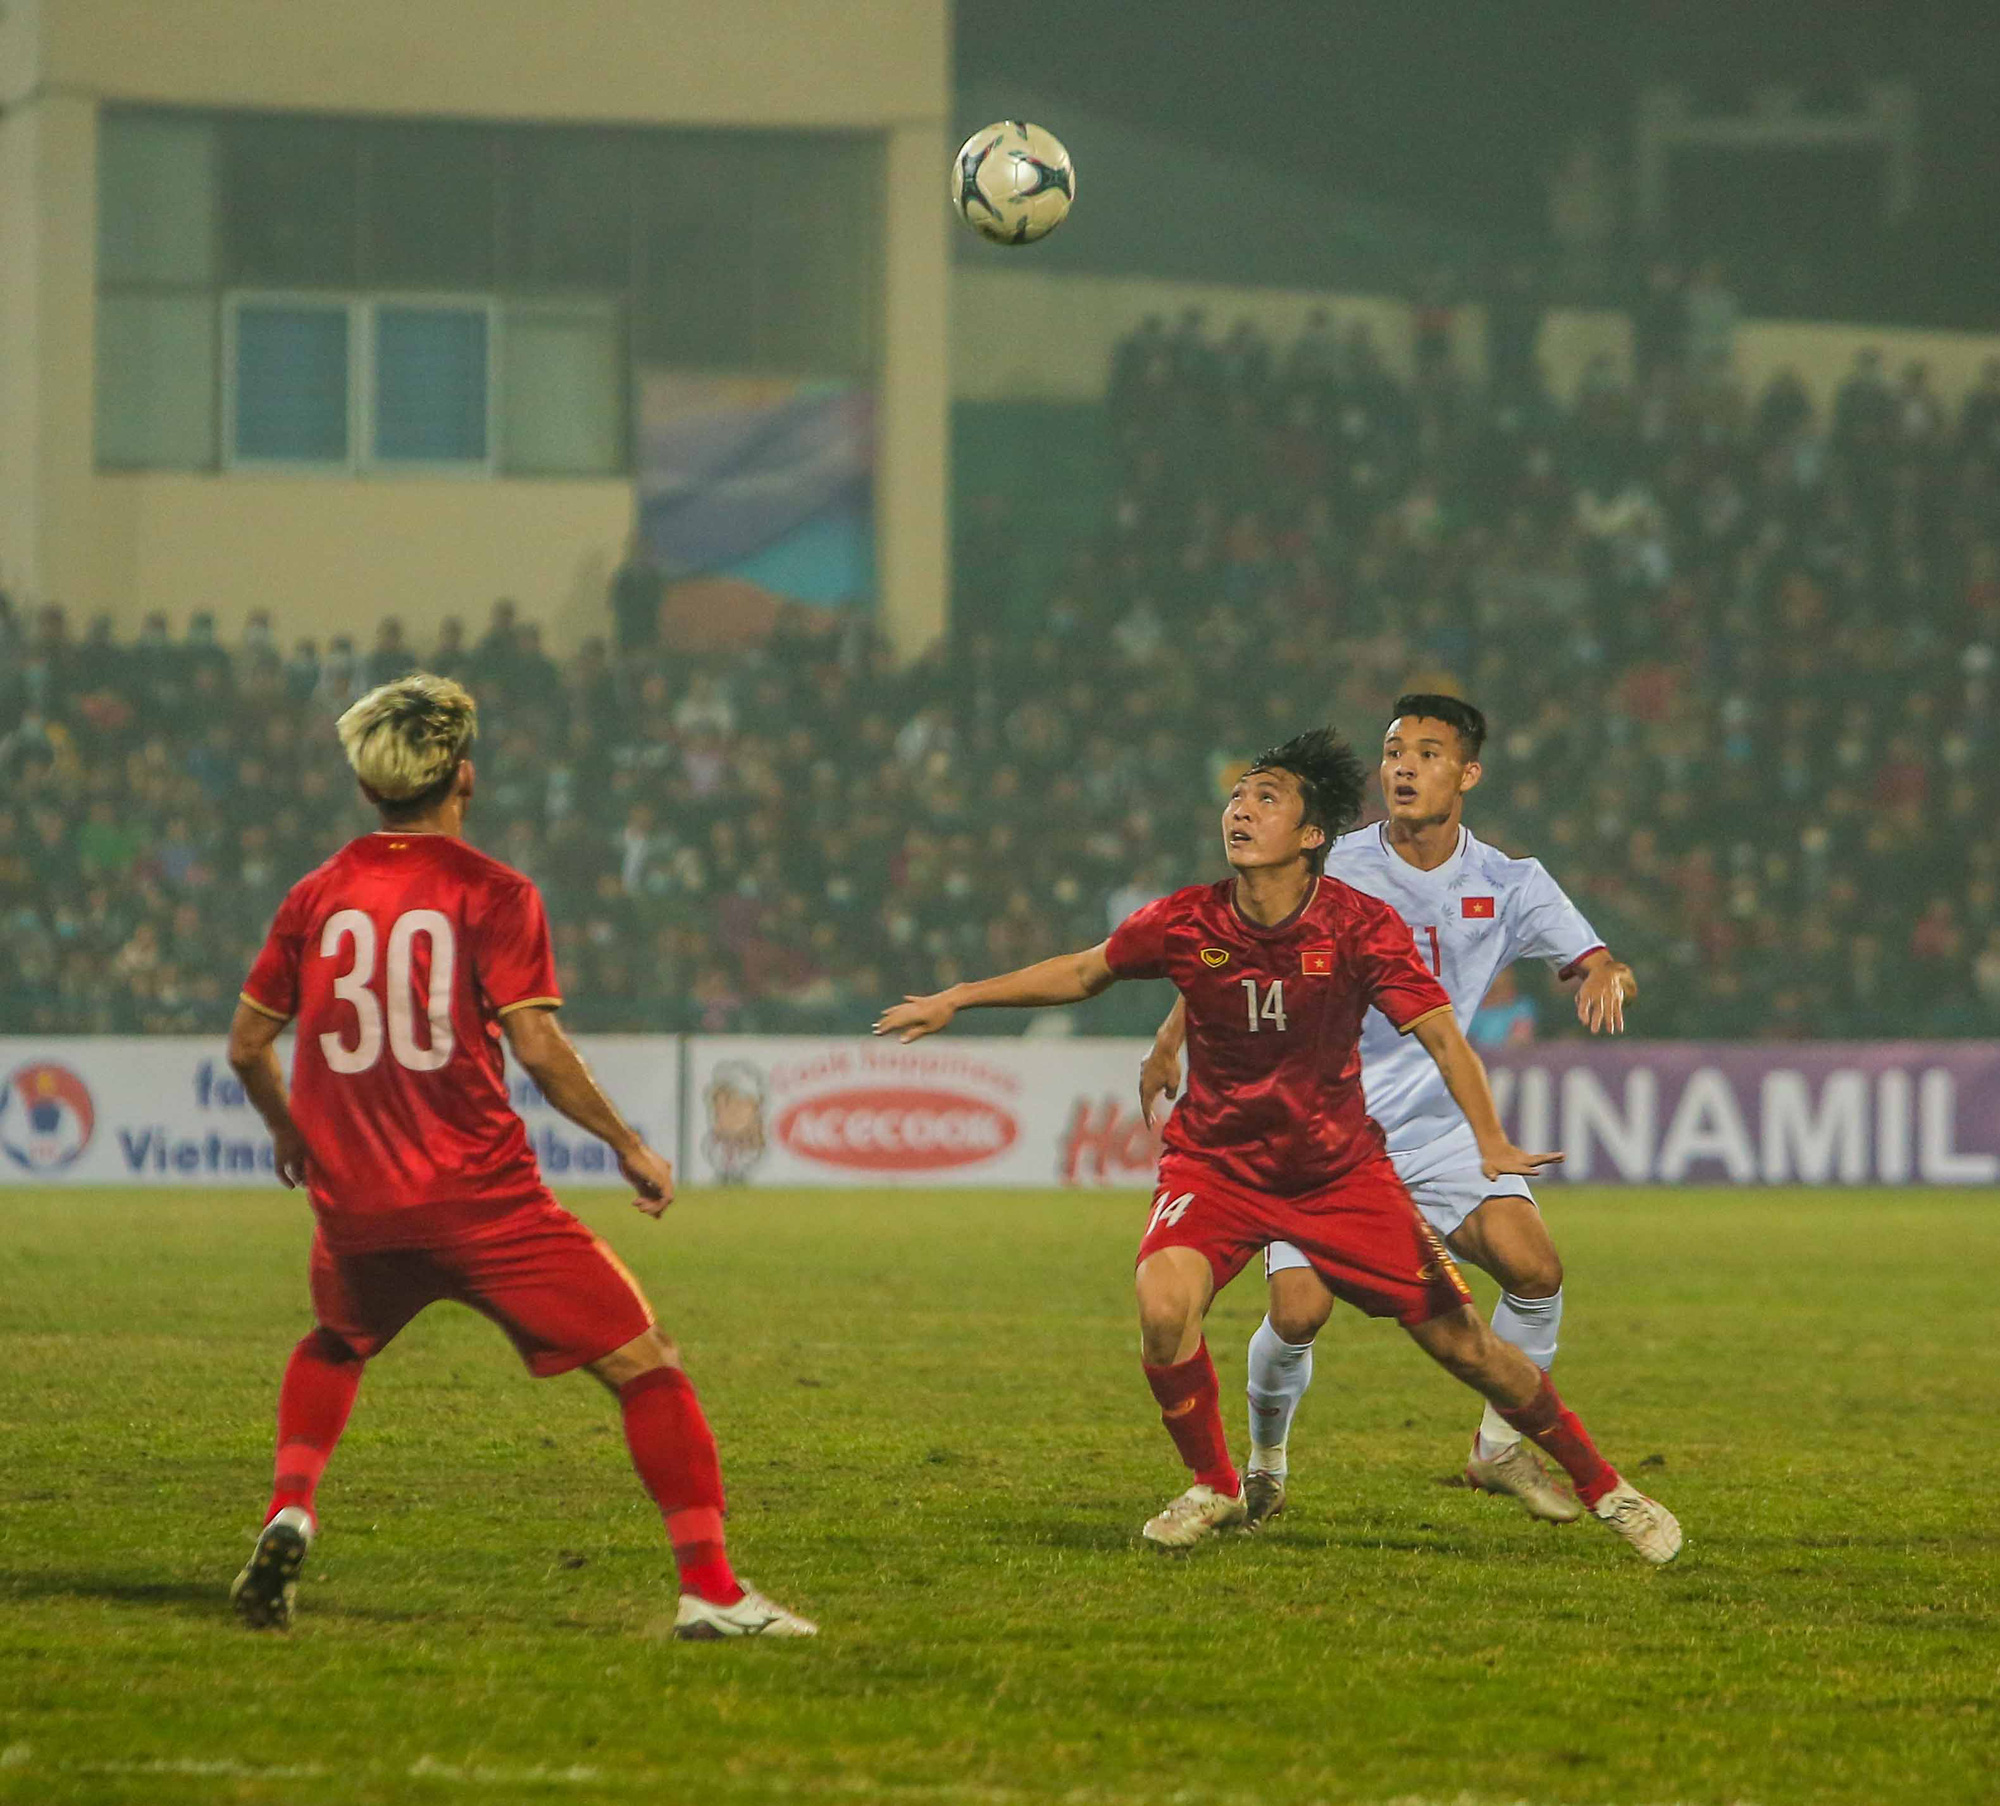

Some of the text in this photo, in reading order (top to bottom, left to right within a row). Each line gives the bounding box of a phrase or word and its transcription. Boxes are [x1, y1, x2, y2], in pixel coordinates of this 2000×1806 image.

[319, 909, 454, 1074] 30
[1241, 979, 1287, 1032] 14
[1145, 1190, 1196, 1235] 14
